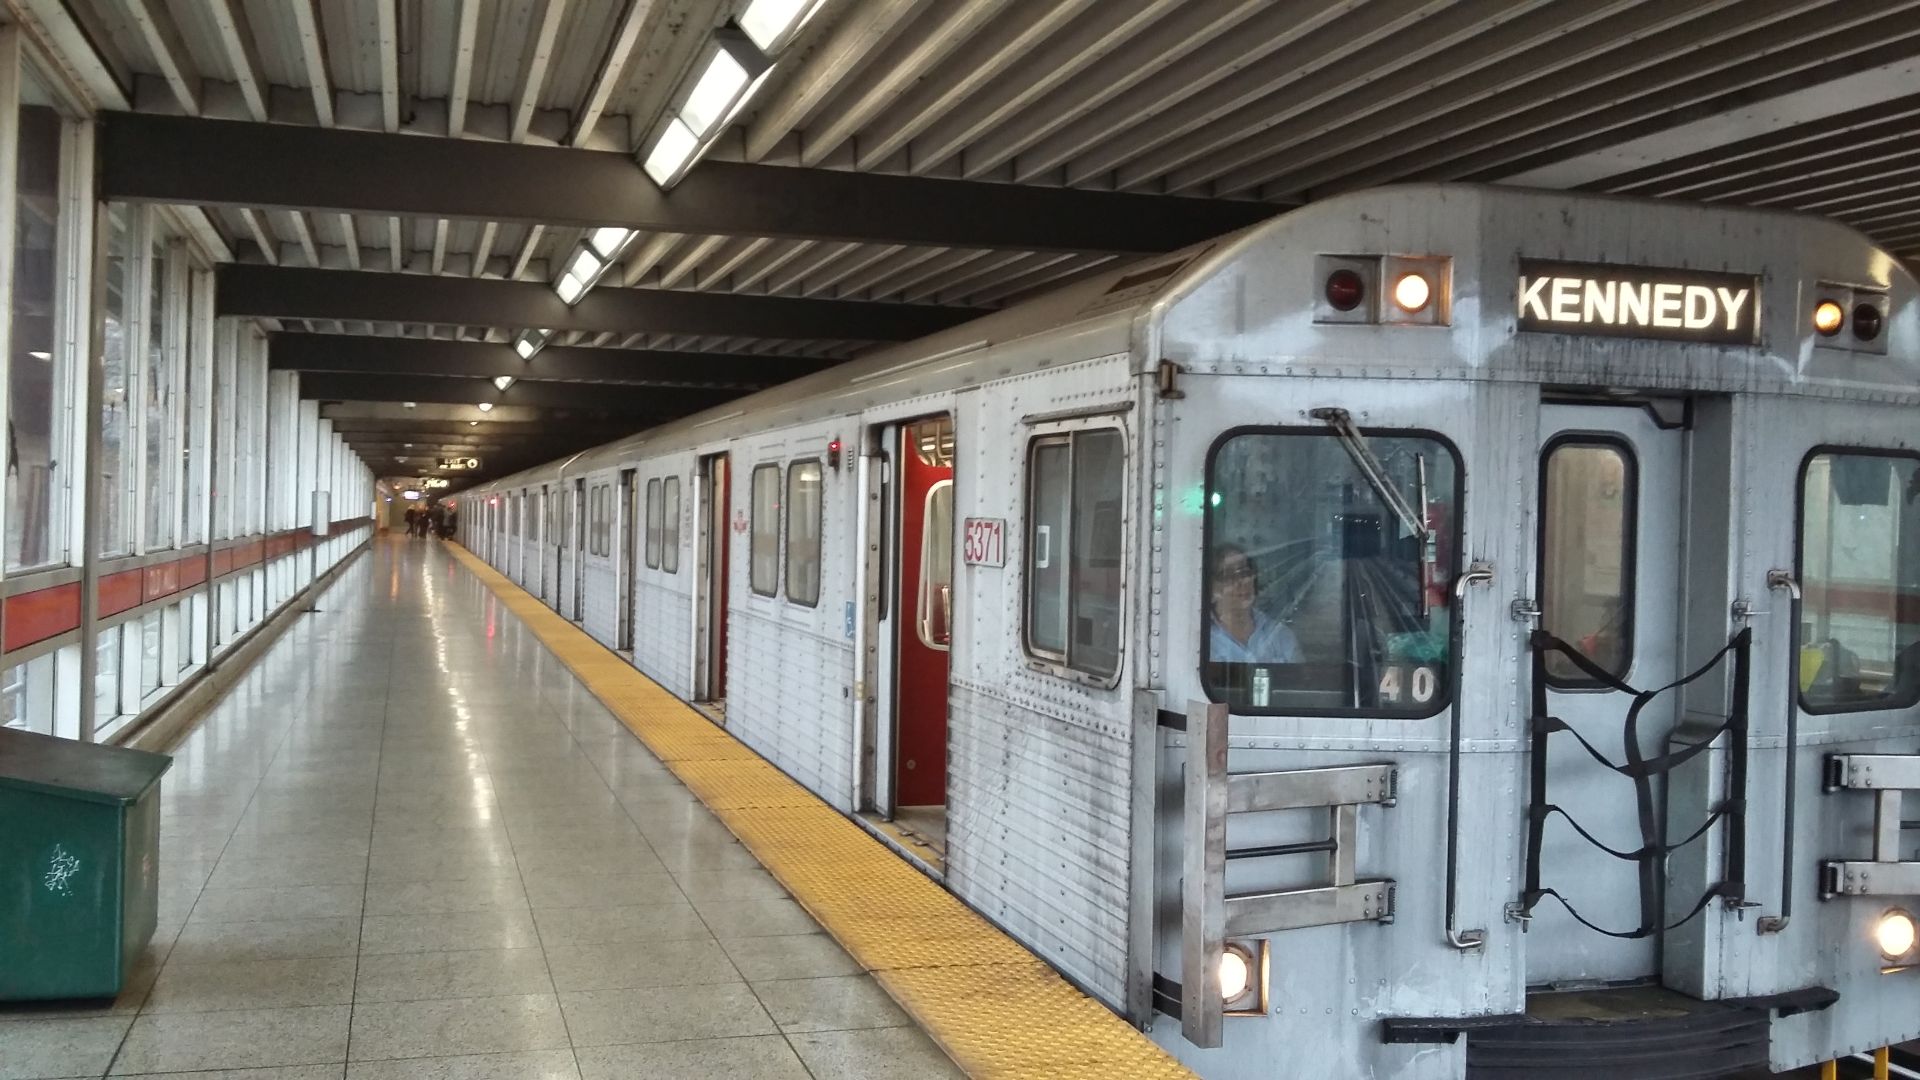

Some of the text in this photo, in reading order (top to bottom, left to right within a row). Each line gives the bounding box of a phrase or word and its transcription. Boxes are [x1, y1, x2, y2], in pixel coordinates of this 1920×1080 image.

[1518, 275, 1749, 331] KENNEDY
[964, 521, 1001, 563] 5371
[1379, 666, 1434, 703] 40
